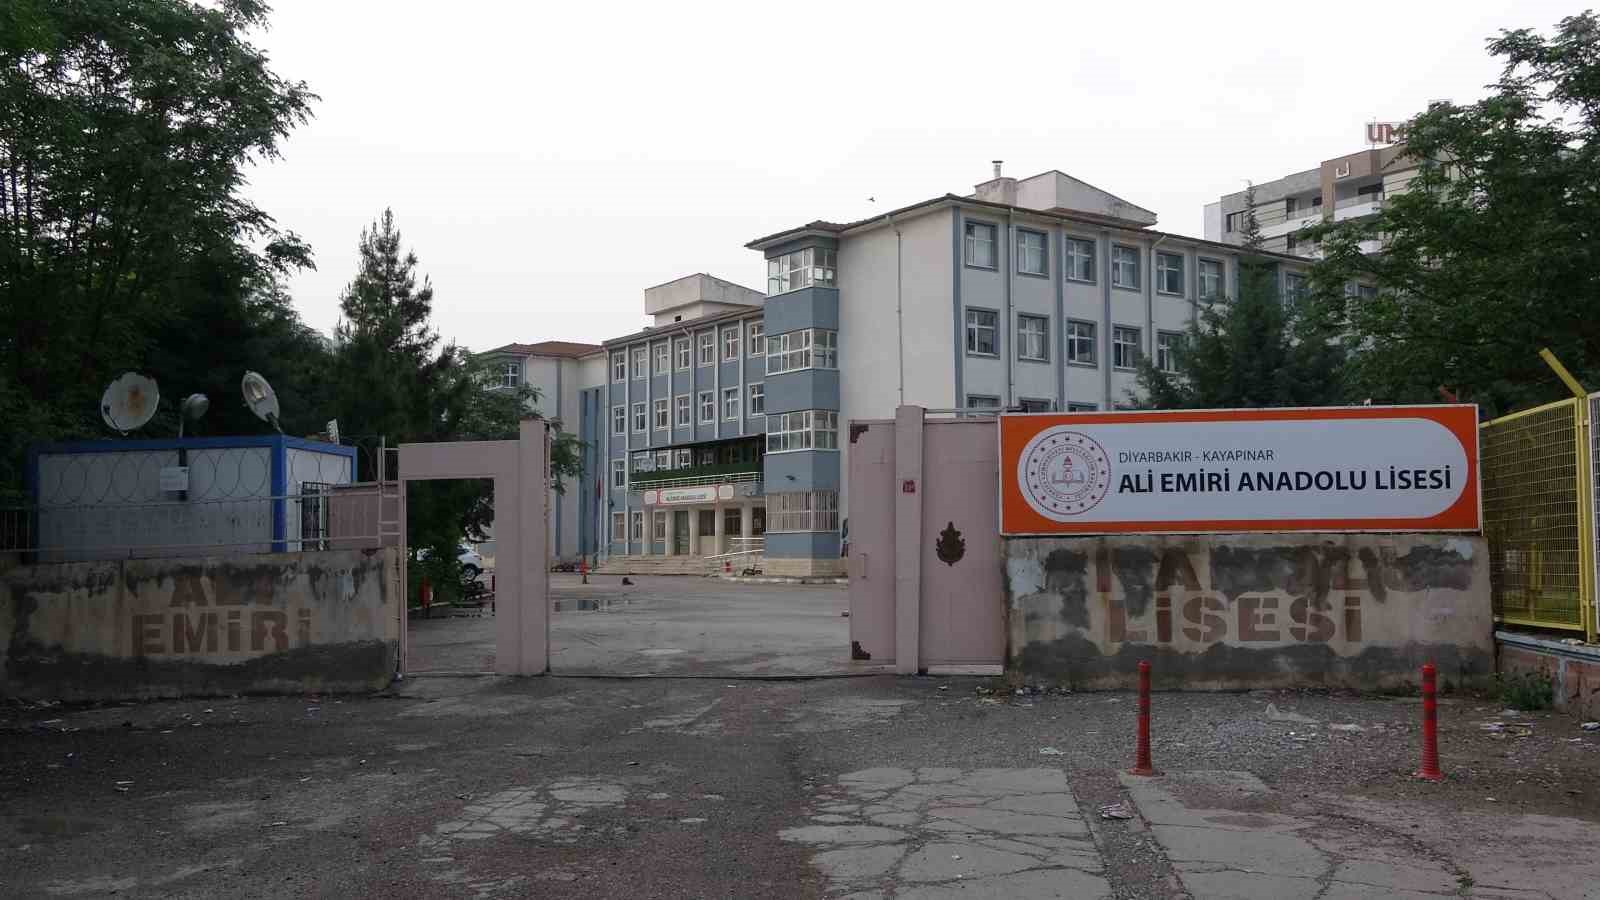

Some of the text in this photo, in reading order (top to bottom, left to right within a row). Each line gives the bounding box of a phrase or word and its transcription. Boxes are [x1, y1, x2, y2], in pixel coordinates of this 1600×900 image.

[1119, 450, 1192, 463] DİYARBAKIR
[1202, 449, 1274, 462] KAYAPINAR
[1118, 469, 1153, 493] ALİ
[1160, 468, 1230, 493] EMİRİ
[1237, 470, 1367, 491] ANADOLU
[1375, 465, 1450, 490] LİSESİ
